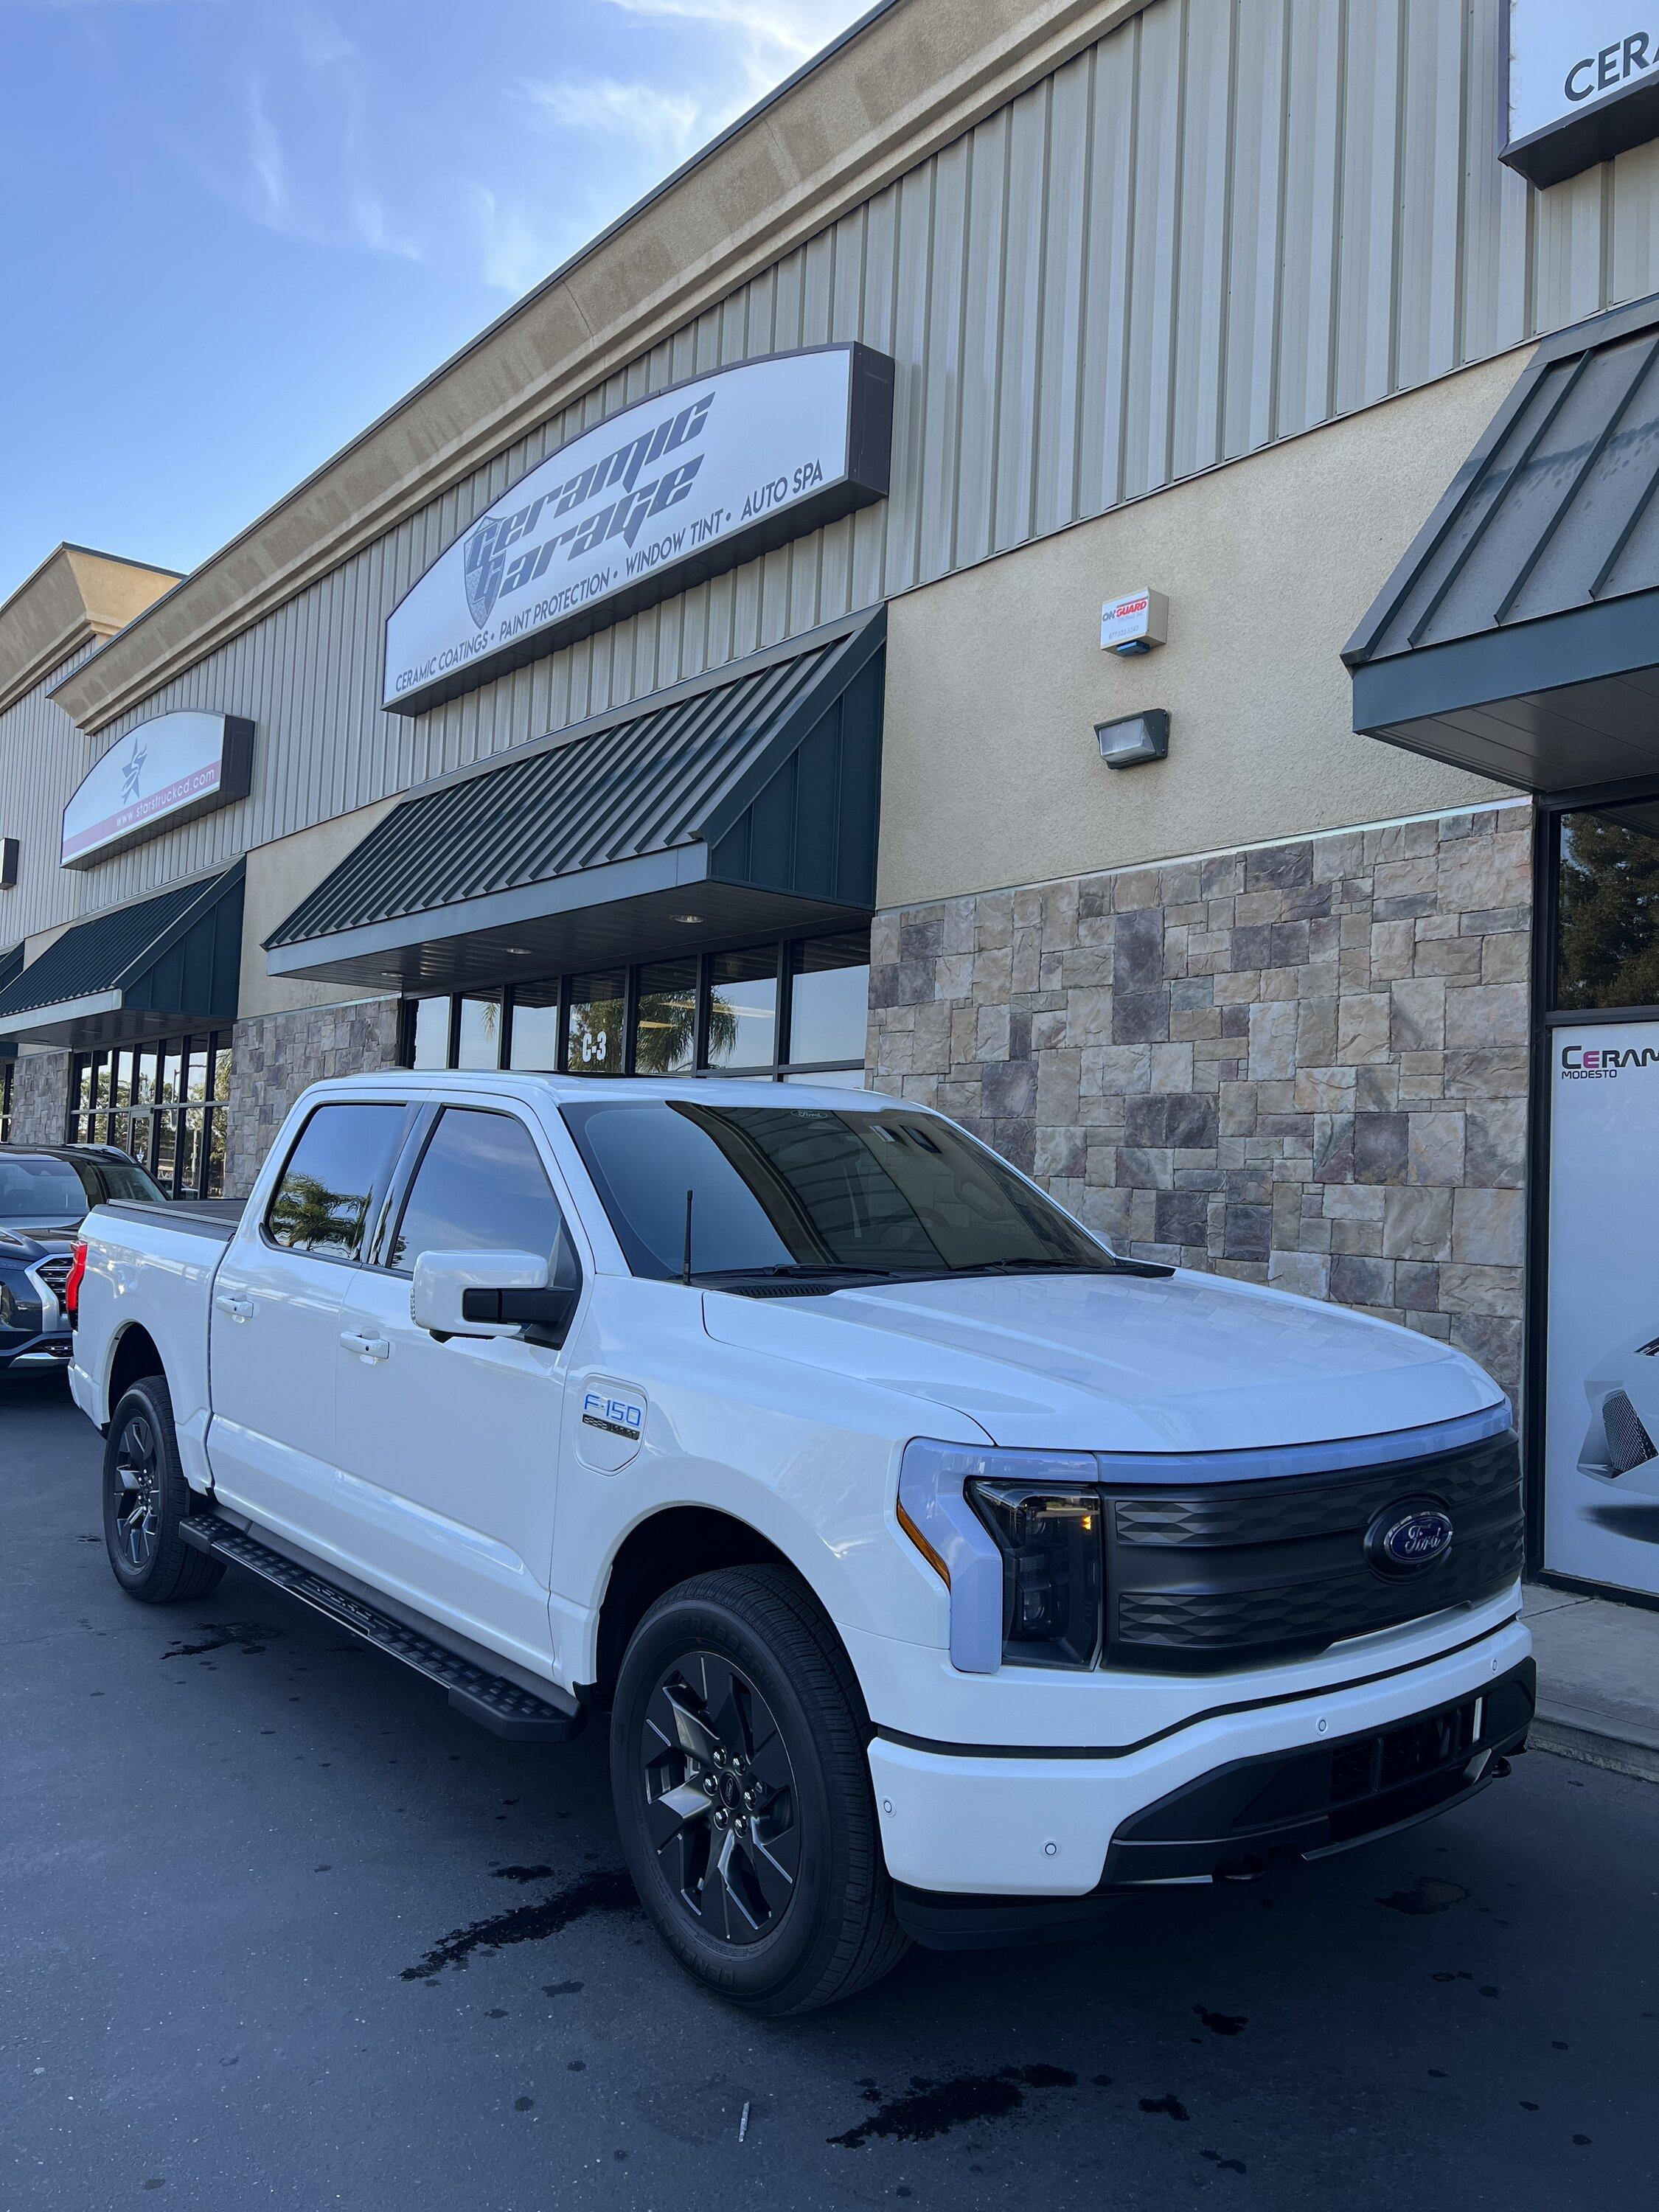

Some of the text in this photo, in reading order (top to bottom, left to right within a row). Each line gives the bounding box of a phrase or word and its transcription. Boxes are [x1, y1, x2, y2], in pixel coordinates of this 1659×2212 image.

[1565, 32, 1659, 101] CER
[396, 458, 824, 692] CERAMIC COATINGS PAINT PROTECTION WINDOW TINT AUTO SPA
[116, 769, 215, 827] www.starstruckcd.com
[1562, 1069, 1618, 1079] MODESTO
[585, 1394, 641, 1426] F-150
[1405, 1523, 1441, 1554] Ford
